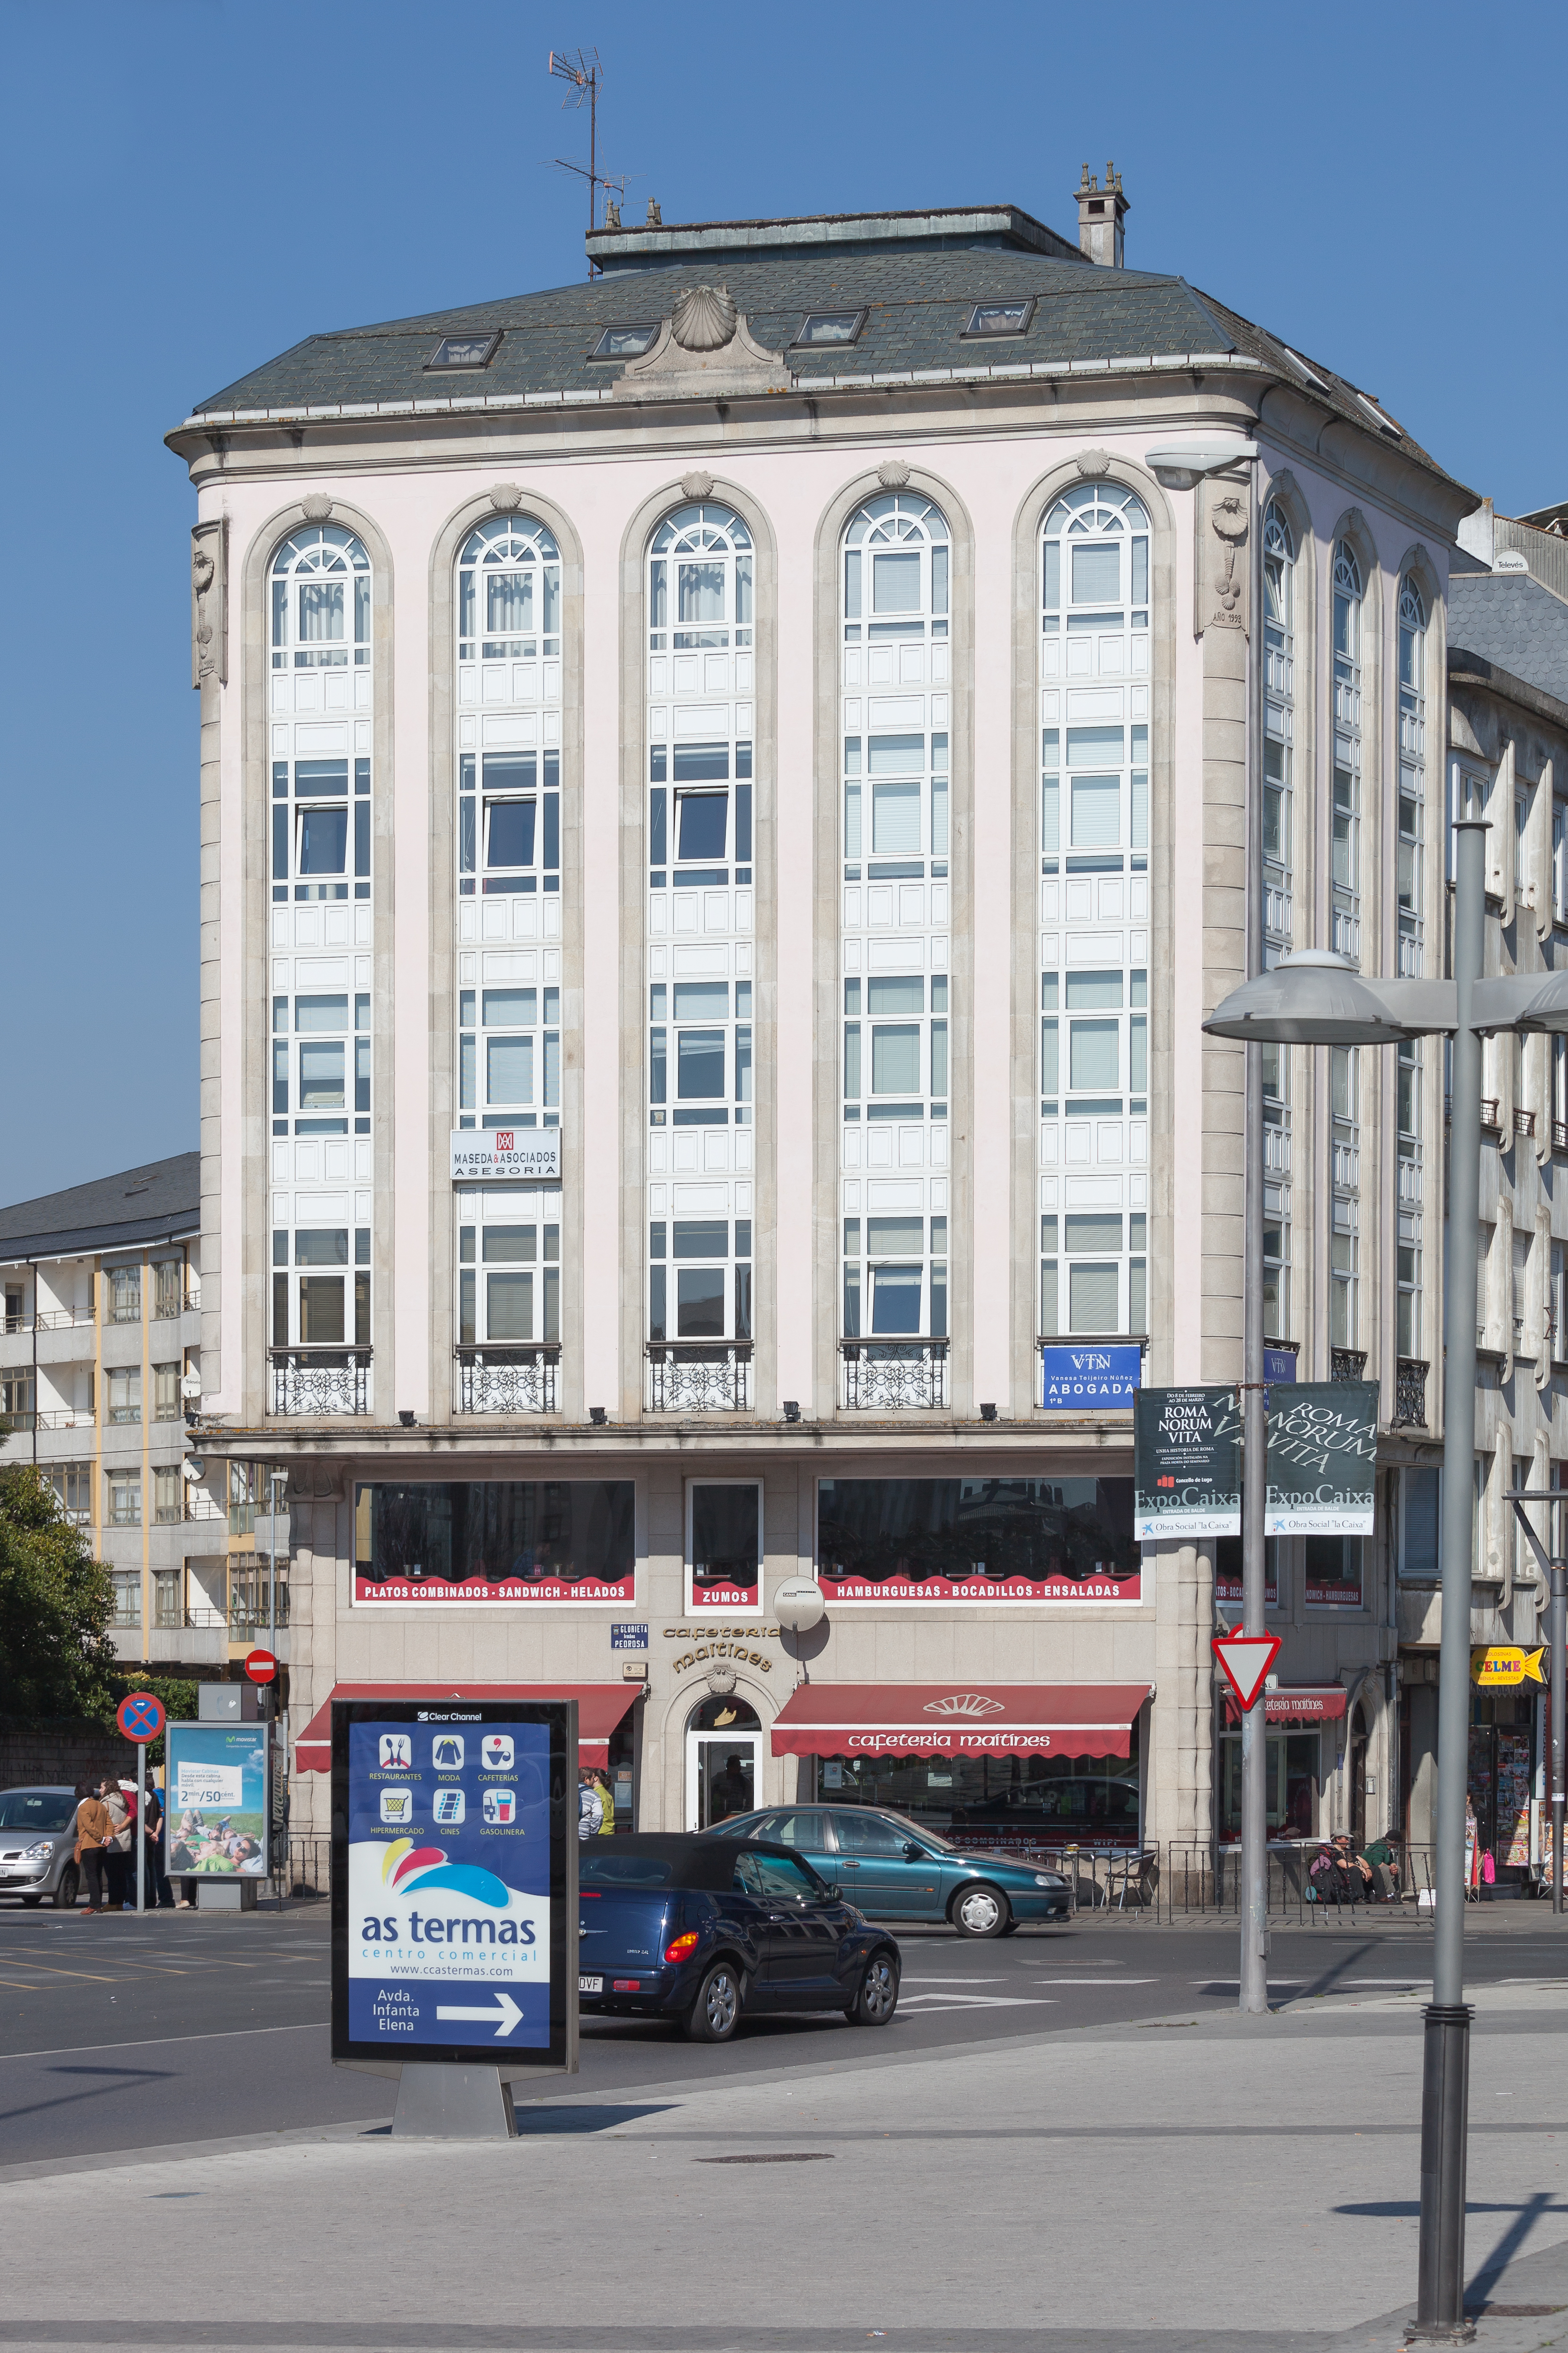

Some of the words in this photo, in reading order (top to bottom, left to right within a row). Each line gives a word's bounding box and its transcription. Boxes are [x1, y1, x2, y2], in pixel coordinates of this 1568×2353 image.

[1228, 614, 1241, 623] 1993
[455, 1167, 556, 1175] ASESORIA
[1049, 1384, 1133, 1394] ABOGADA
[1164, 1405, 1208, 1419] ROMA
[1158, 1418, 1213, 1431] NORUM
[1289, 1402, 1376, 1440] ROMA
[1168, 1431, 1202, 1443] VITA
[1268, 1411, 1377, 1462] NORUM
[1267, 1431, 1329, 1475] VITA
[1135, 1487, 1241, 1513] ExpoCaixa
[1266, 1484, 1374, 1509] ExpoCaixa
[1175, 1522, 1196, 1530] Social
[365, 1587, 408, 1597] PLATOS
[412, 1587, 488, 1597] COMBINADOS
[499, 1587, 560, 1597] SANDWICH
[571, 1586, 625, 1597] HELADOS
[703, 1592, 748, 1602] ZUMOS
[837, 1586, 940, 1597] HAMBURGUESAS
[952, 1585, 1033, 1597] BOCADILLOS
[1044, 1585, 1119, 1596] ENSALADAS
[1326, 1591, 1359, 1601] HAMBURGUESAS
[1475, 1661, 1521, 1672] CELME
[430, 1713, 449, 1721] Clear
[362, 1916, 398, 1942] as
[408, 1911, 536, 1945] termas
[362, 1948, 425, 1959] centro
[439, 1950, 536, 1961] comercial
[391, 1965, 513, 1976] www.ccastermas.com
[579, 1978, 599, 1990] DVF
[378, 1989, 414, 2002] Avda.
[373, 2004, 420, 2016] Infanta
[379, 2018, 414, 2031] Elena
